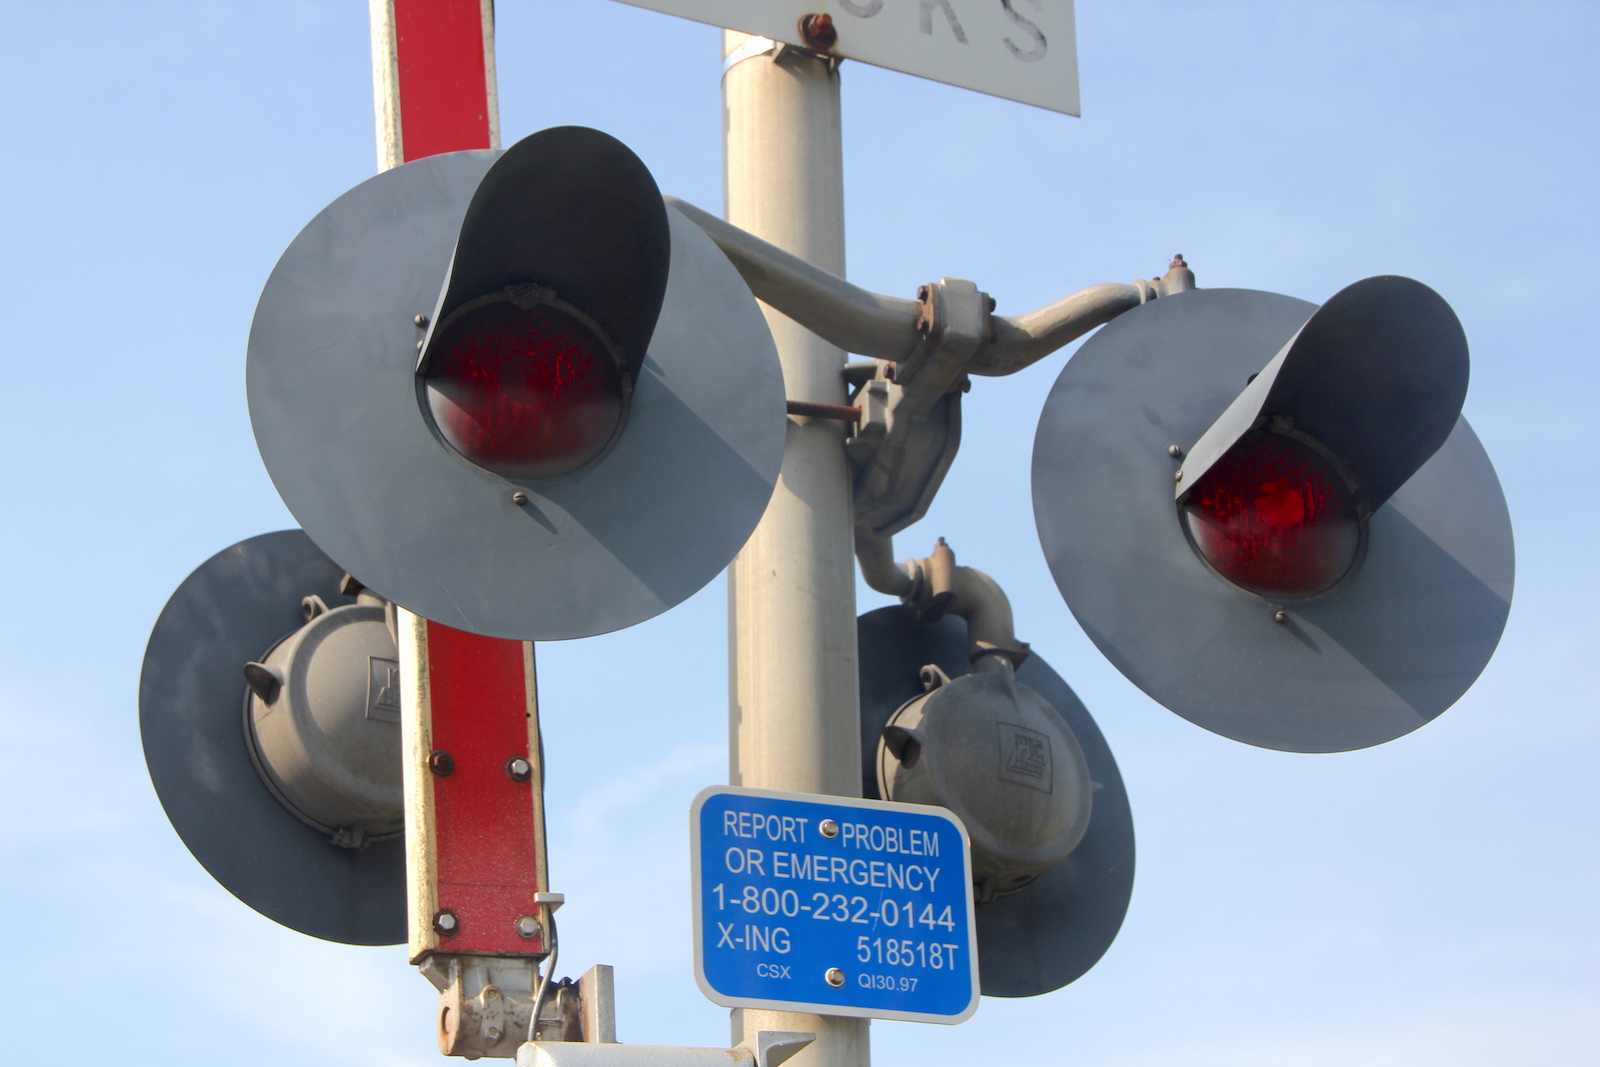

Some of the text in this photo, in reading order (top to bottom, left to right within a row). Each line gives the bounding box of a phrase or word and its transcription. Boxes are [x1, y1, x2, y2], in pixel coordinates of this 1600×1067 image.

[723, 810, 939, 857] REPORT PROBLEM
[725, 847, 940, 892] OR EMERGENCY
[712, 883, 955, 932] 1-800-232-0144
[717, 922, 958, 970] X-ING 518518T
[756, 963, 791, 979] CSX
